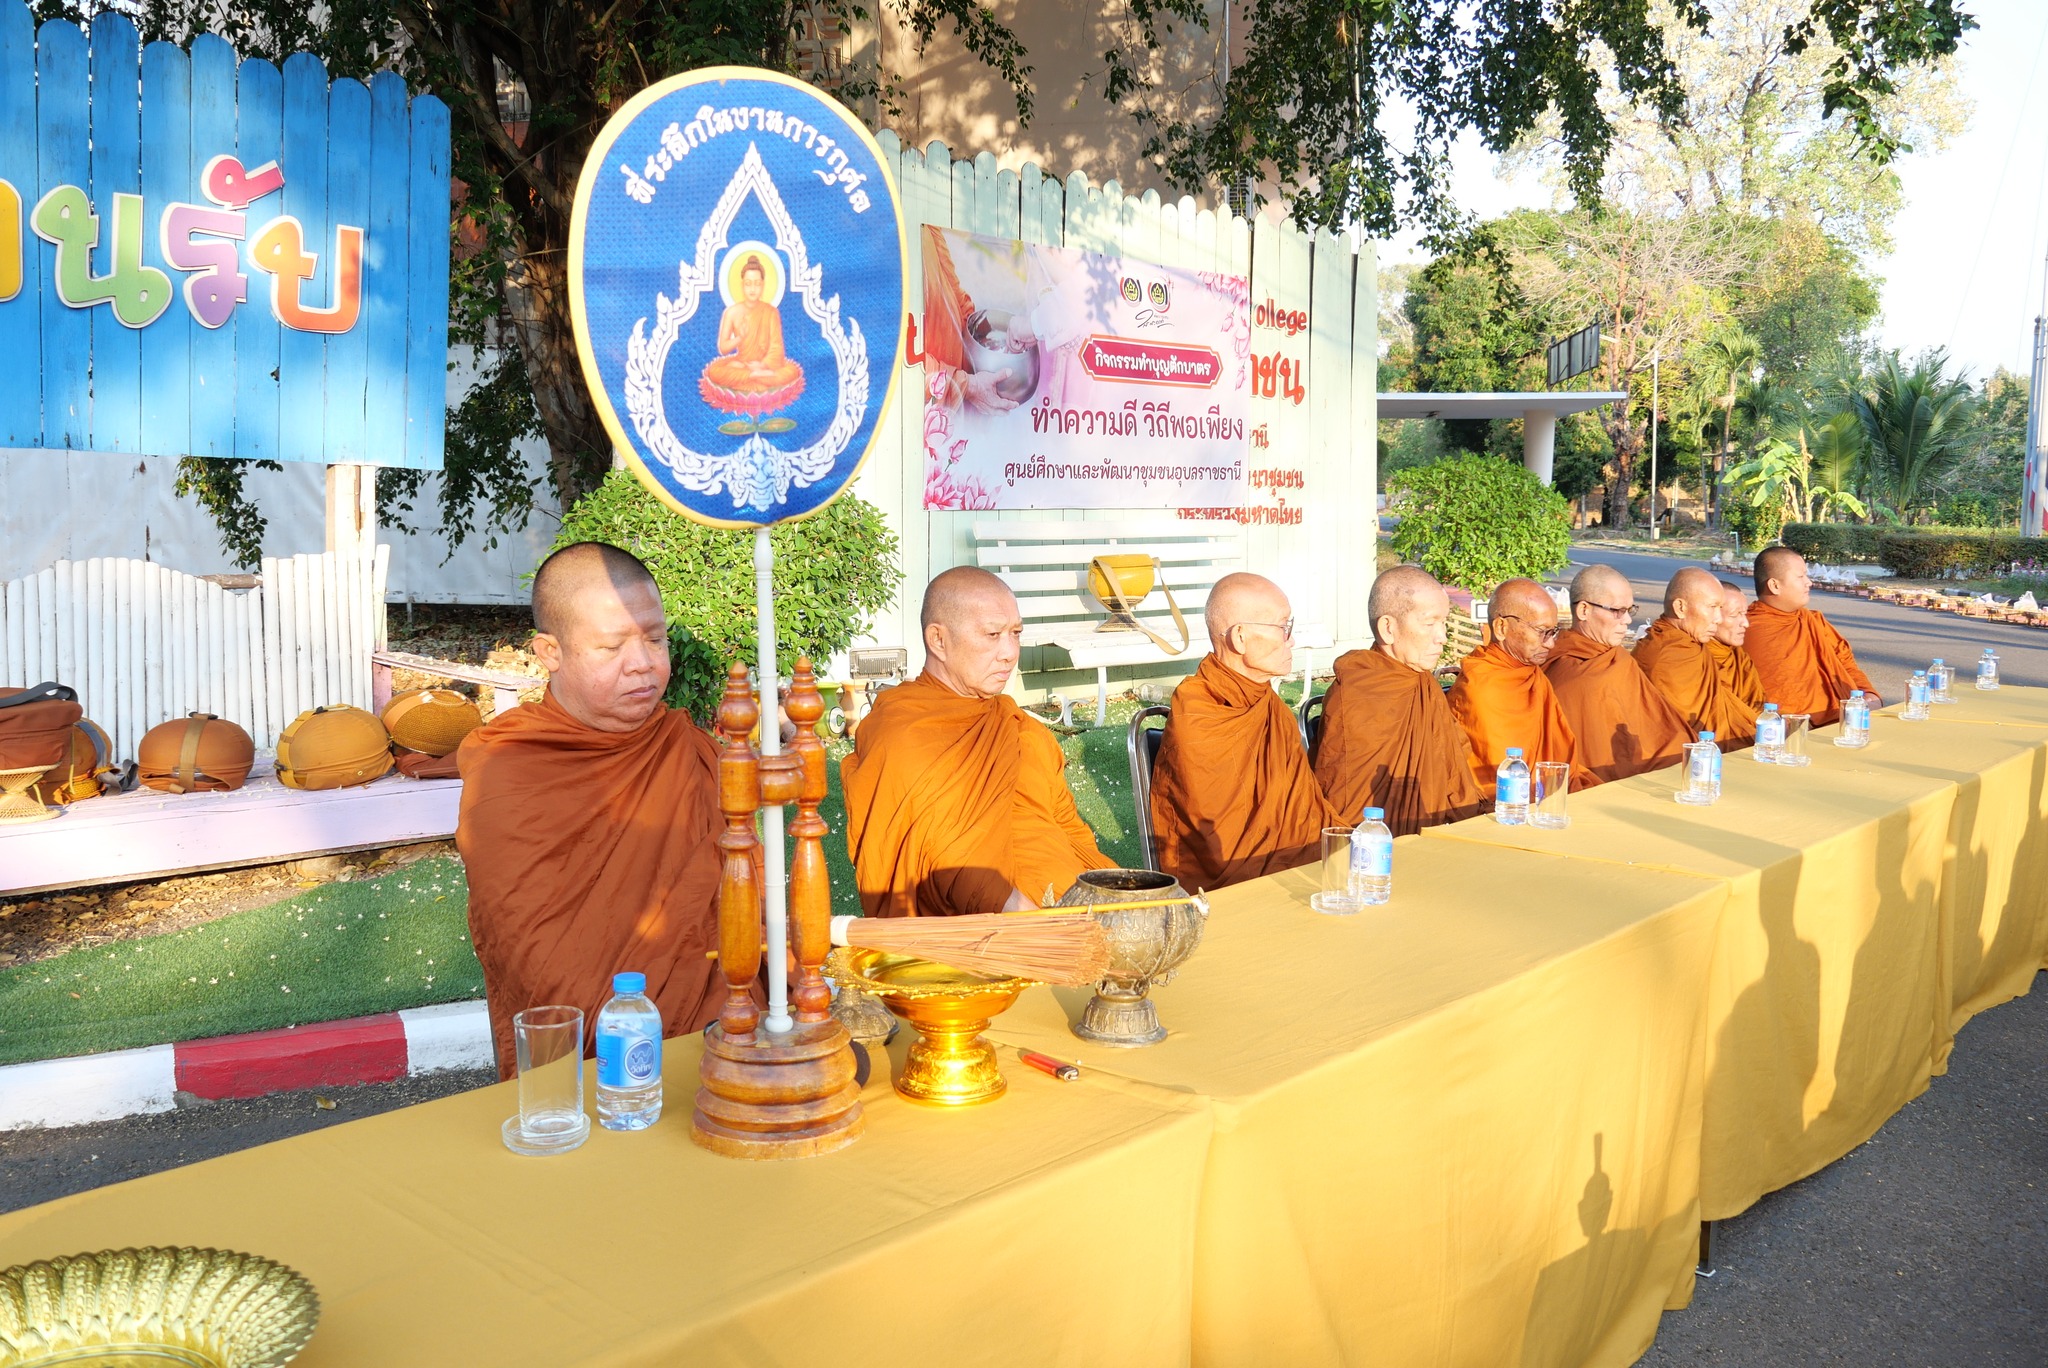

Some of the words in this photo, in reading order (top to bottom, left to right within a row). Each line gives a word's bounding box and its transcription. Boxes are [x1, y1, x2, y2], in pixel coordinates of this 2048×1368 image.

[0, 154, 365, 334] นรับ
[1255, 298, 1307, 336] ollege
[1094, 347, 1212, 379] กิจกรรมทำบุญตักบาตร
[1031, 396, 1138, 437] ทำความดี
[1142, 401, 1243, 440] วิถีพอเพียง
[1004, 453, 1242, 488] ศูนย์ศึกษาและพัฒนาชุมชนอุบลราชธานี
[1248, 467, 1304, 497] นาชุมชน
